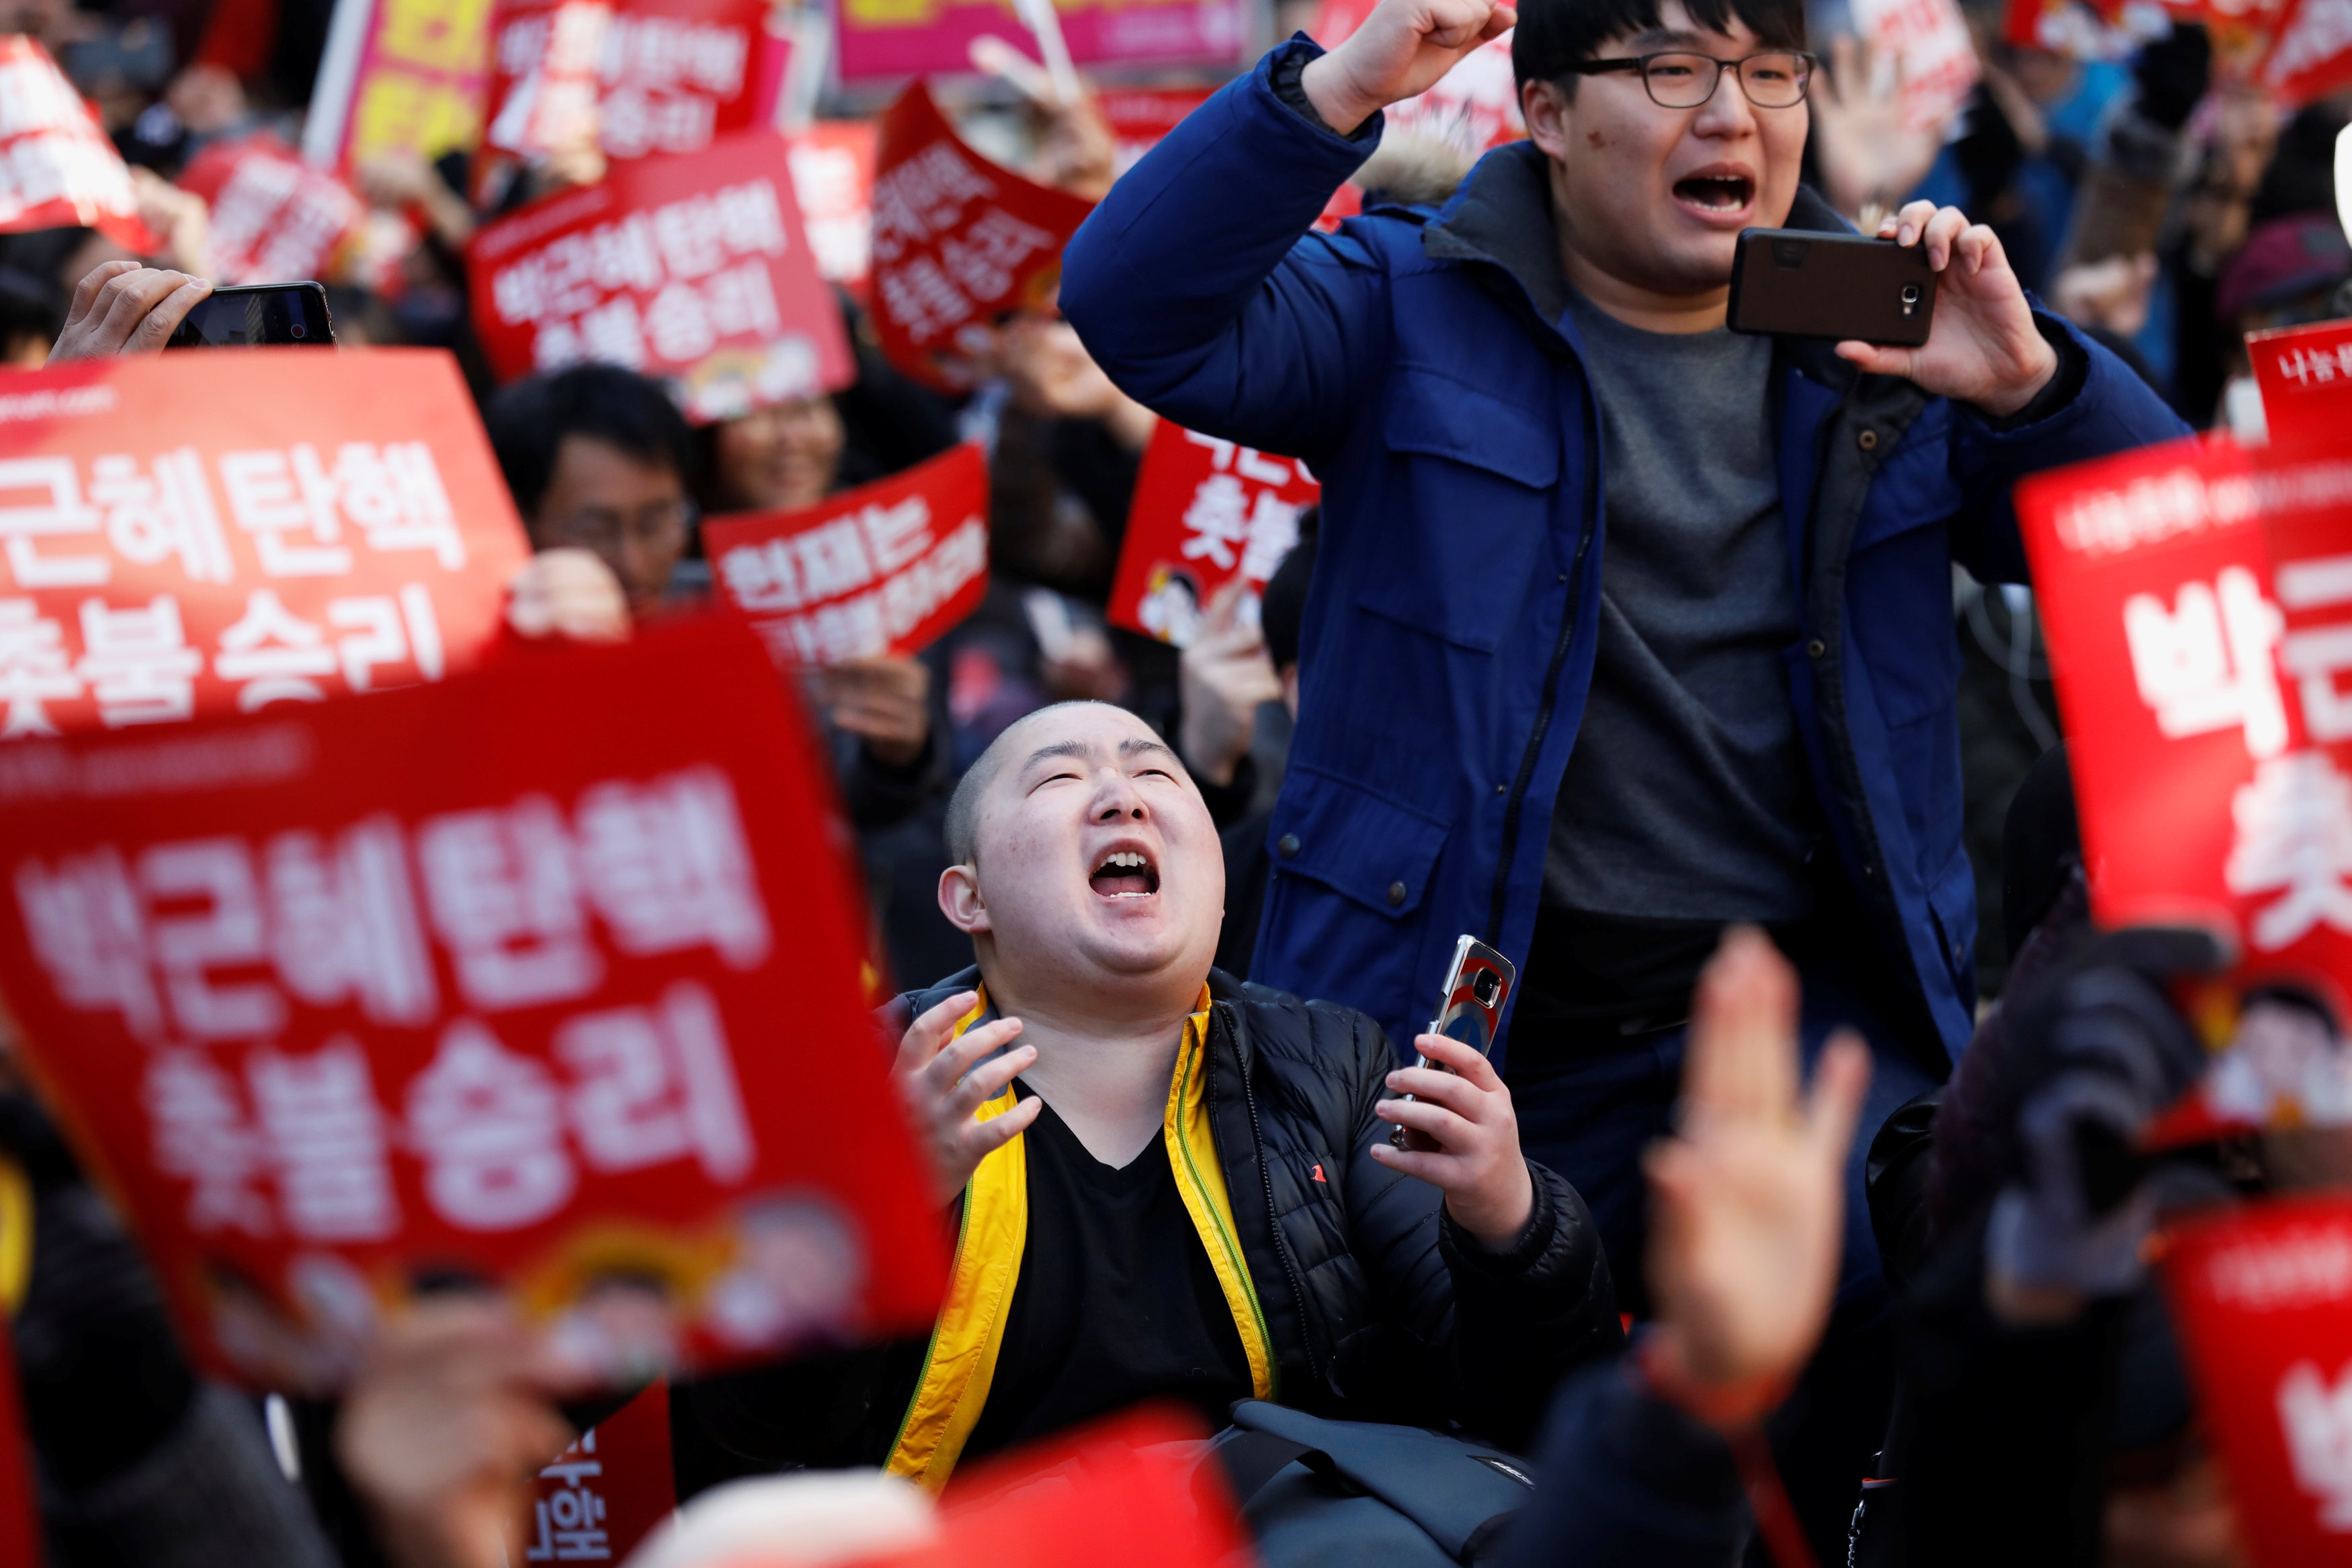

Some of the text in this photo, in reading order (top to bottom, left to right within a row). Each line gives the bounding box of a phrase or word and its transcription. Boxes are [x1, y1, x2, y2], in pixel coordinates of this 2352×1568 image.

[218, 441, 466, 579] 탄핵
[214, 583, 446, 713] 승리
[13, 762, 773, 1039] 박근혜 탄핵
[398, 977, 757, 1232] 승리
